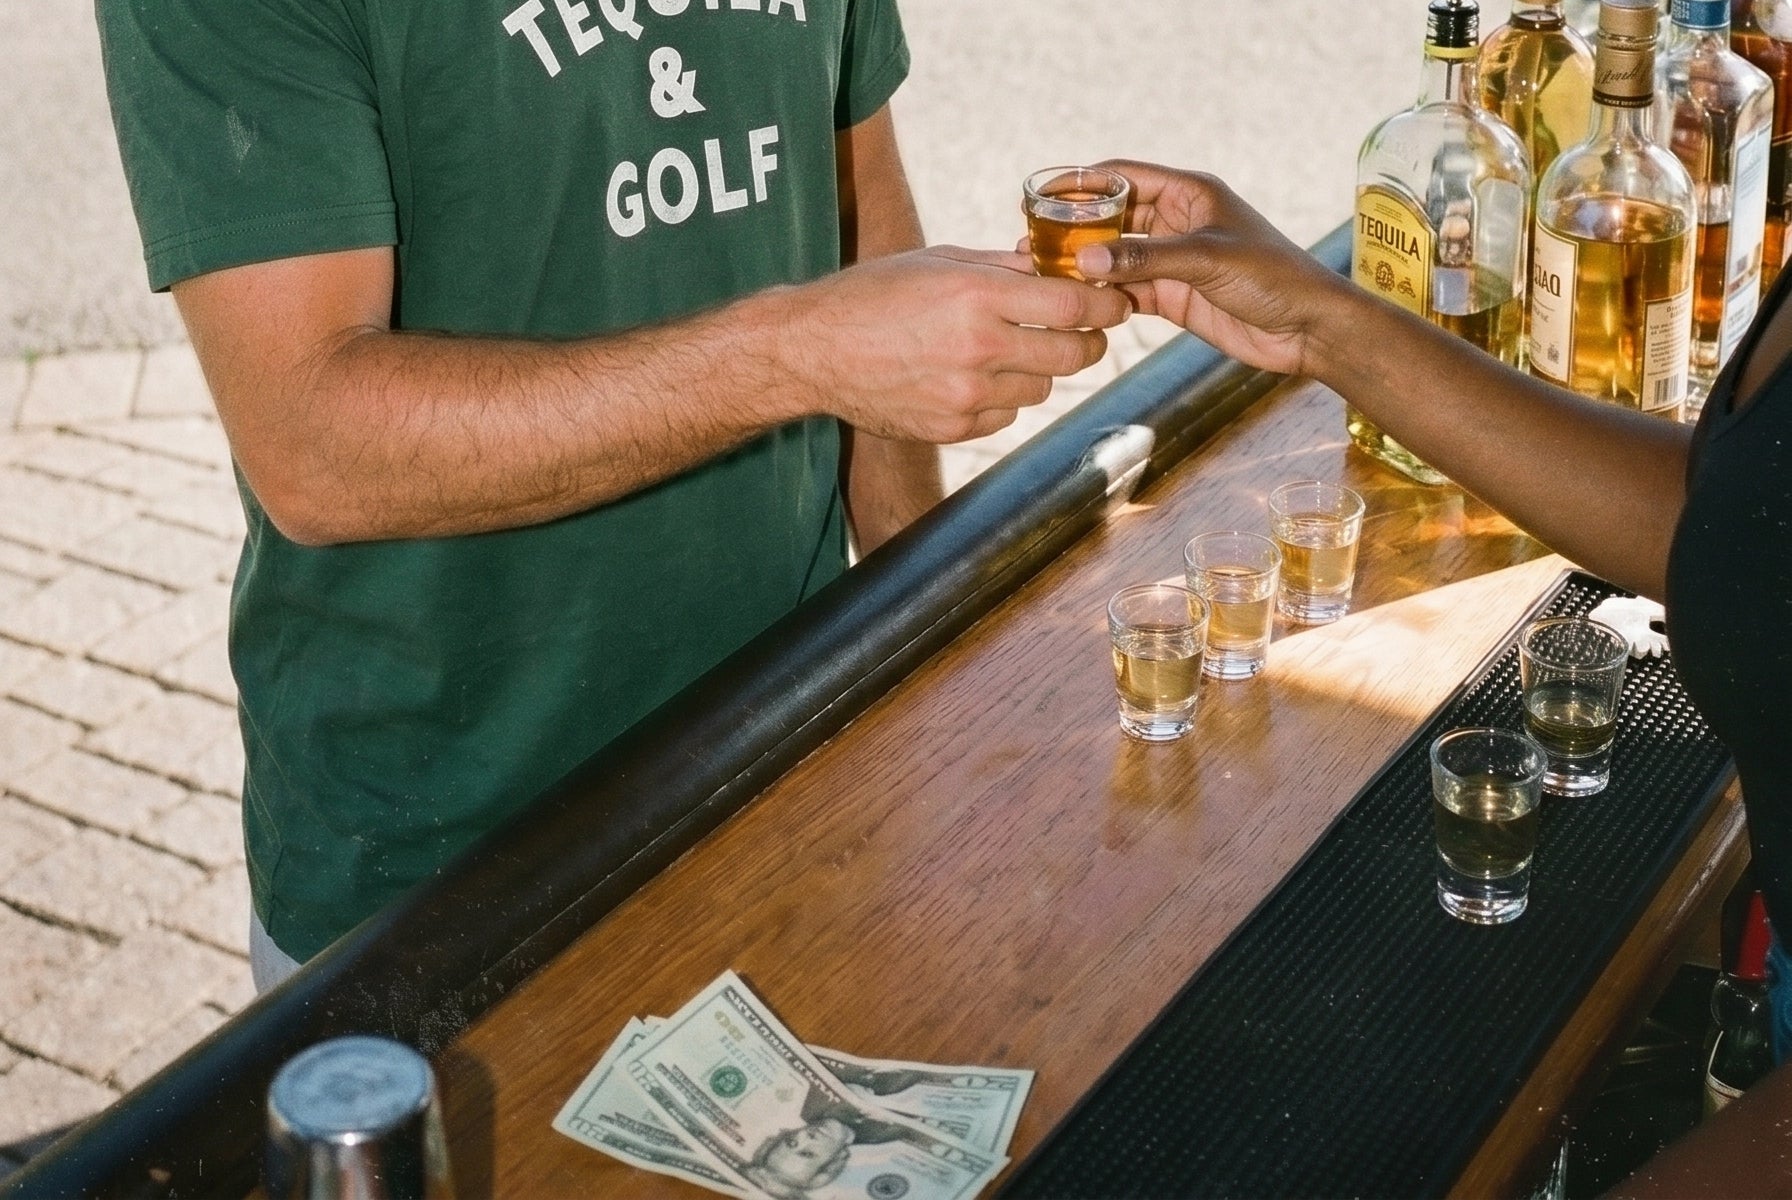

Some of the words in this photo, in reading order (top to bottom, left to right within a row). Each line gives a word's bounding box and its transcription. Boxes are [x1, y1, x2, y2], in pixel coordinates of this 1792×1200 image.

[649, 46, 706, 118] &
[606, 124, 779, 237] GOLF
[1358, 212, 1422, 262] TEQUILA
